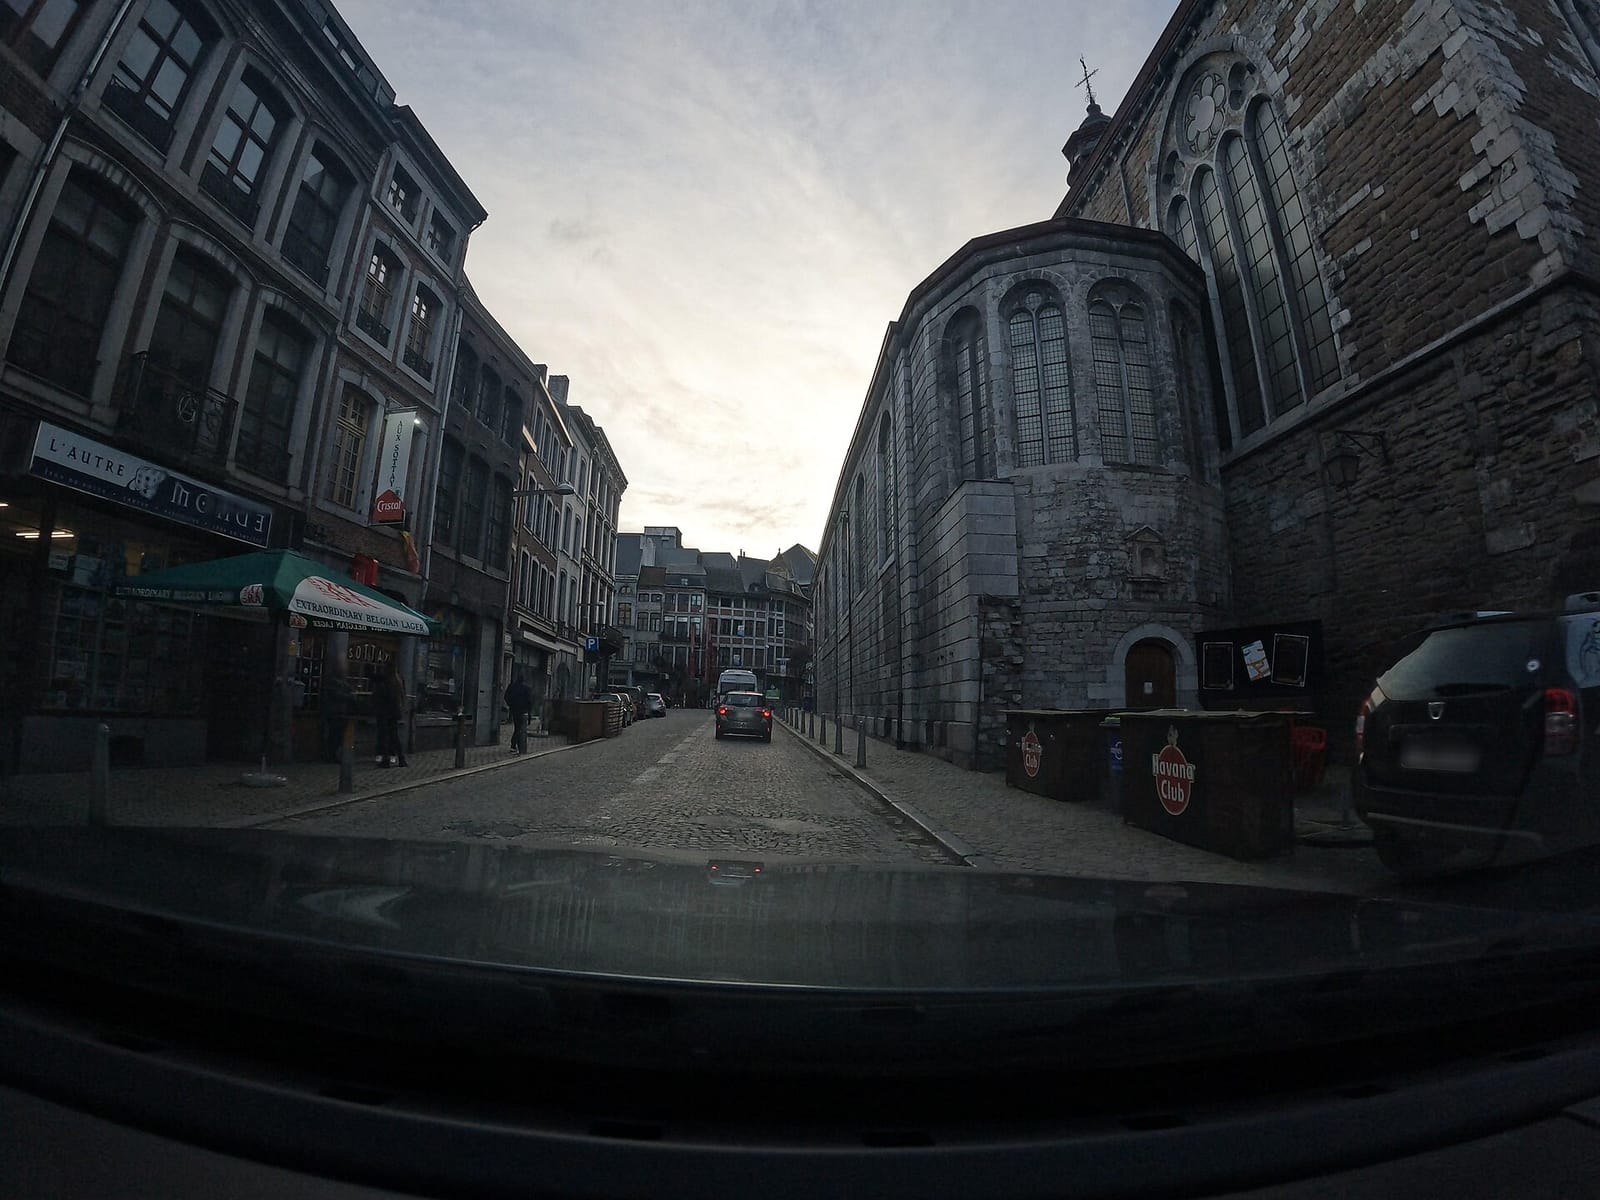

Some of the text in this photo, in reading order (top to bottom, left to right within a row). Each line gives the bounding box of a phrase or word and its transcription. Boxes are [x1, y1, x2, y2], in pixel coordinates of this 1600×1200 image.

[50, 439, 124, 476] L'AUTRE
[377, 500, 401, 512] Cristal
[296, 599, 363, 621] EXTRAORDINARY
[367, 614, 399, 627] BELGIAN
[401, 621, 424, 632] LAGER
[588, 639, 596, 648] P
[1152, 754, 1194, 782] Havana
[1161, 780, 1184, 802] Club
